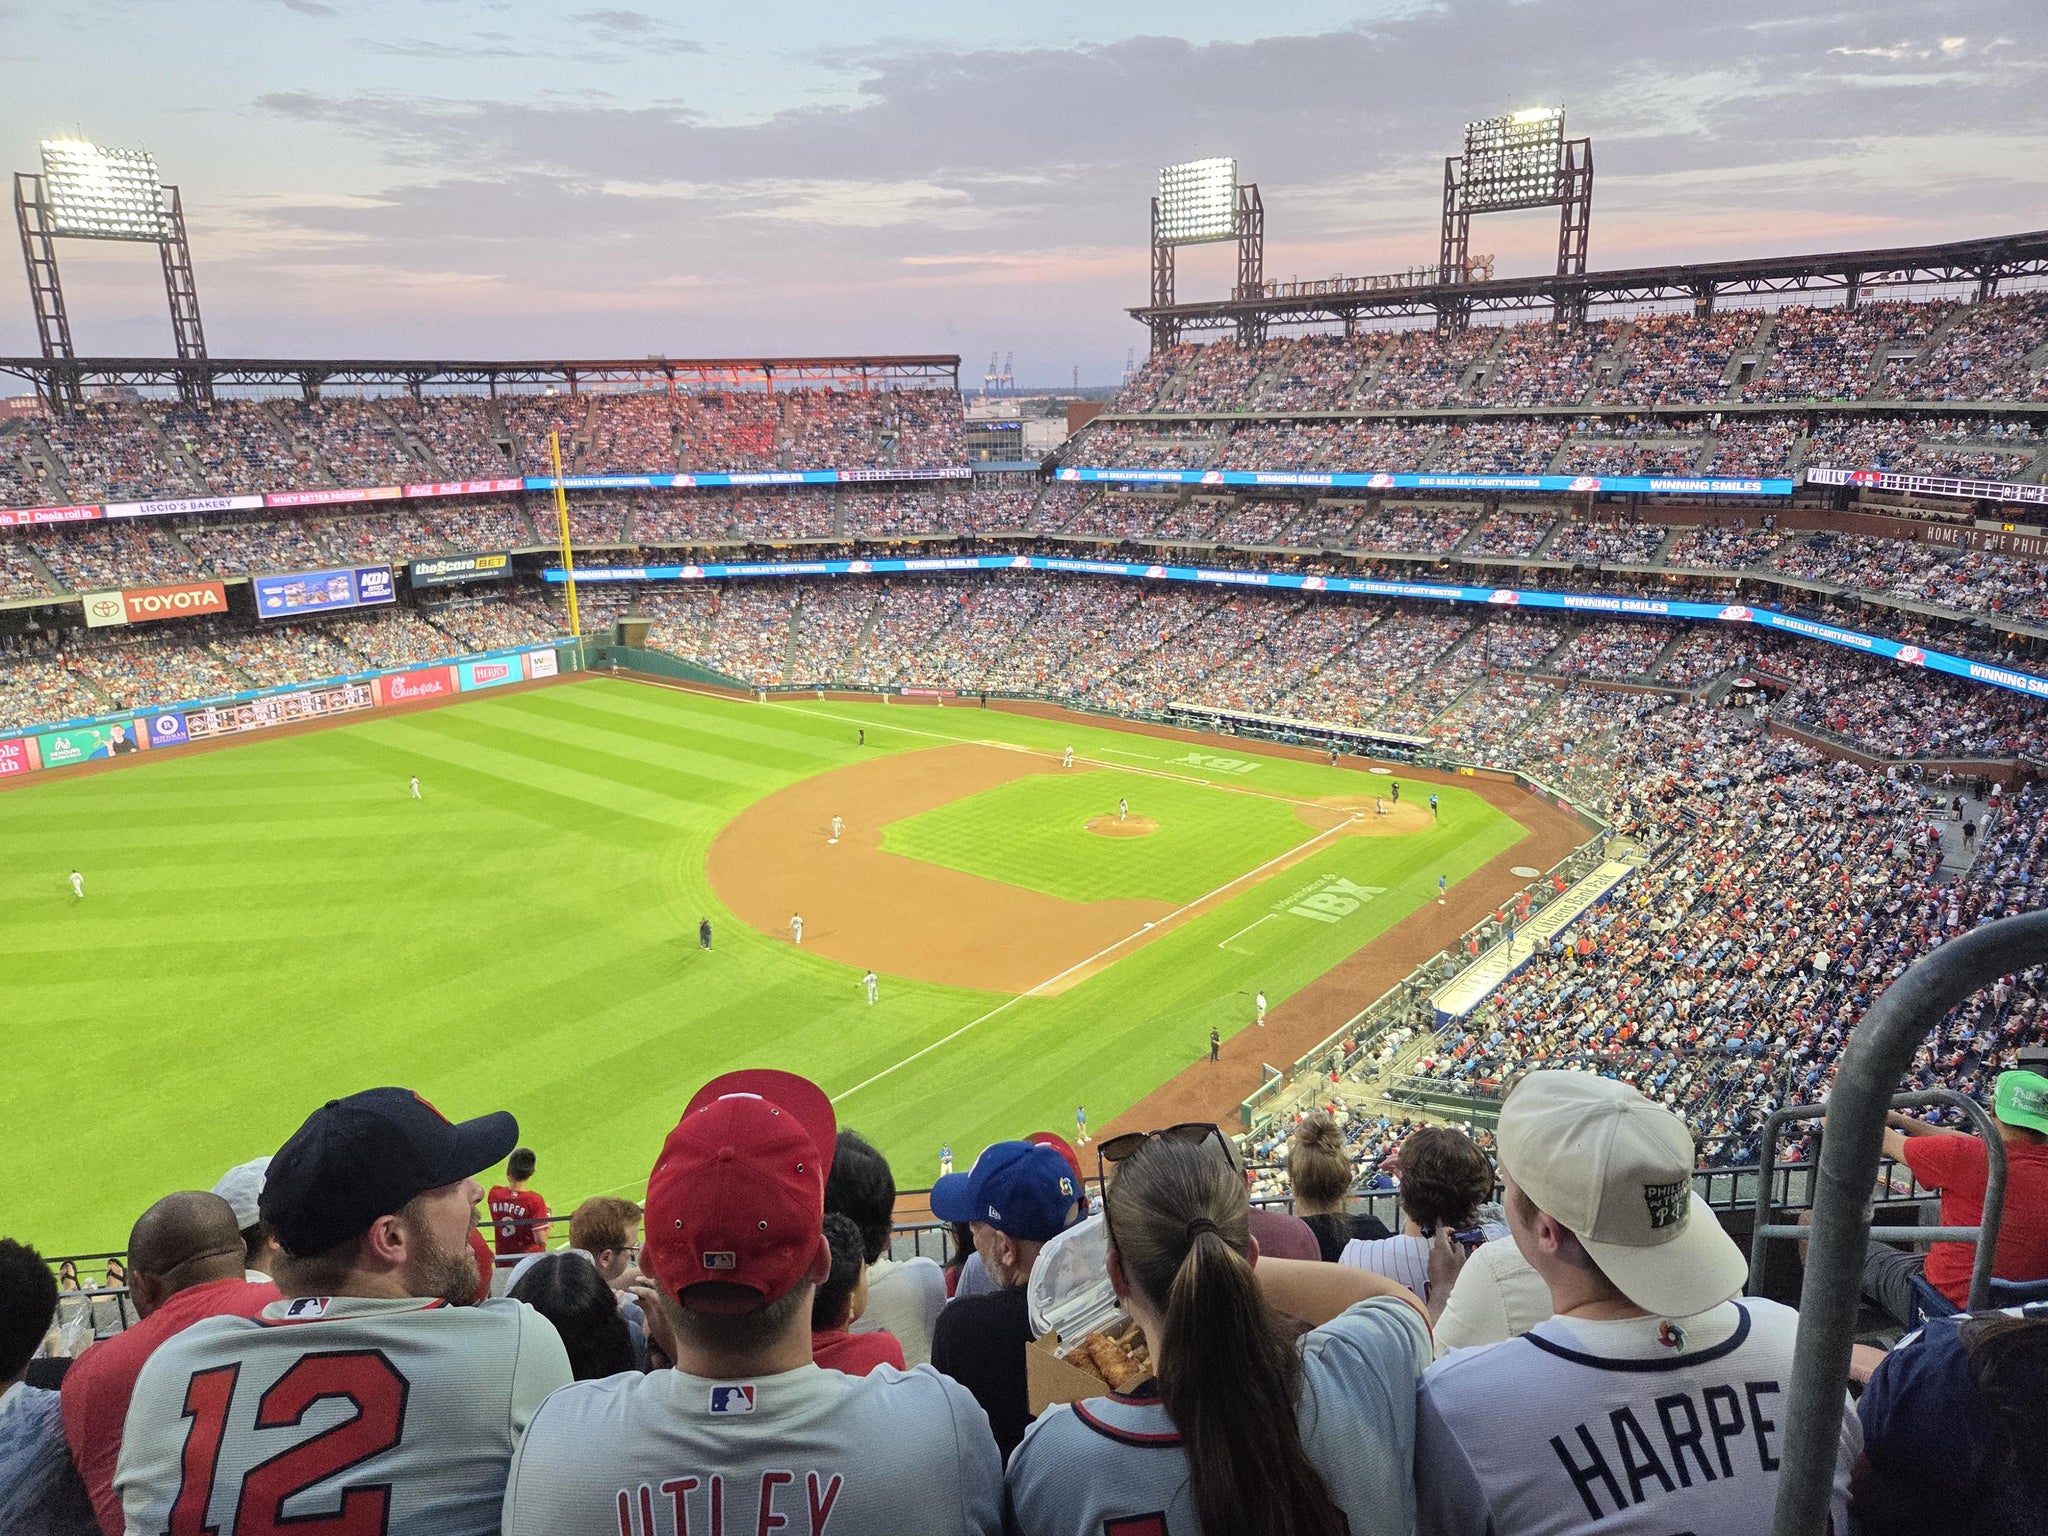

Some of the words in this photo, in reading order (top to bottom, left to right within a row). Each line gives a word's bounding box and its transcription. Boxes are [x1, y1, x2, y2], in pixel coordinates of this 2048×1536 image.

[1256, 475, 1296, 483] WINNING
[1298, 475, 1332, 483] SMILES
[1504, 479, 1540, 487] BUSTERS
[1650, 480, 1709, 491] WINNING
[1711, 481, 1762, 491] SMILES
[35, 511, 62, 521] Deals
[64, 509, 81, 518] roll
[83, 508, 91, 517] in
[141, 502, 187, 513] LISCIO'S
[191, 500, 232, 510] BAKERY
[1927, 526, 1958, 543] HOME
[416, 560, 476, 576] theScore
[479, 556, 503, 568] BET
[1349, 582, 1365, 590] DOC
[1404, 586, 1429, 595] CAVITY
[129, 590, 219, 613] TOYOTA
[1564, 596, 1620, 609] WINNING
[1622, 600, 1668, 612] SMILES
[1819, 628, 1841, 641] CAVITY
[1841, 632, 1872, 648] BUSTERS
[477, 667, 505, 679] HERR'S
[1970, 665, 2027, 689] WINNING
[0, 760, 20, 773] th
[1287, 877, 1388, 923] IBX
[1531, 902, 1578, 934] Citizens
[1566, 887, 1596, 907] Bank
[1585, 873, 1617, 890] Park
[492, 1202, 526, 1218] HARPER
[501, 1216, 516, 1237] 3
[160, 1348, 411, 1536] 12
[1549, 1381, 1780, 1521] HARPE
